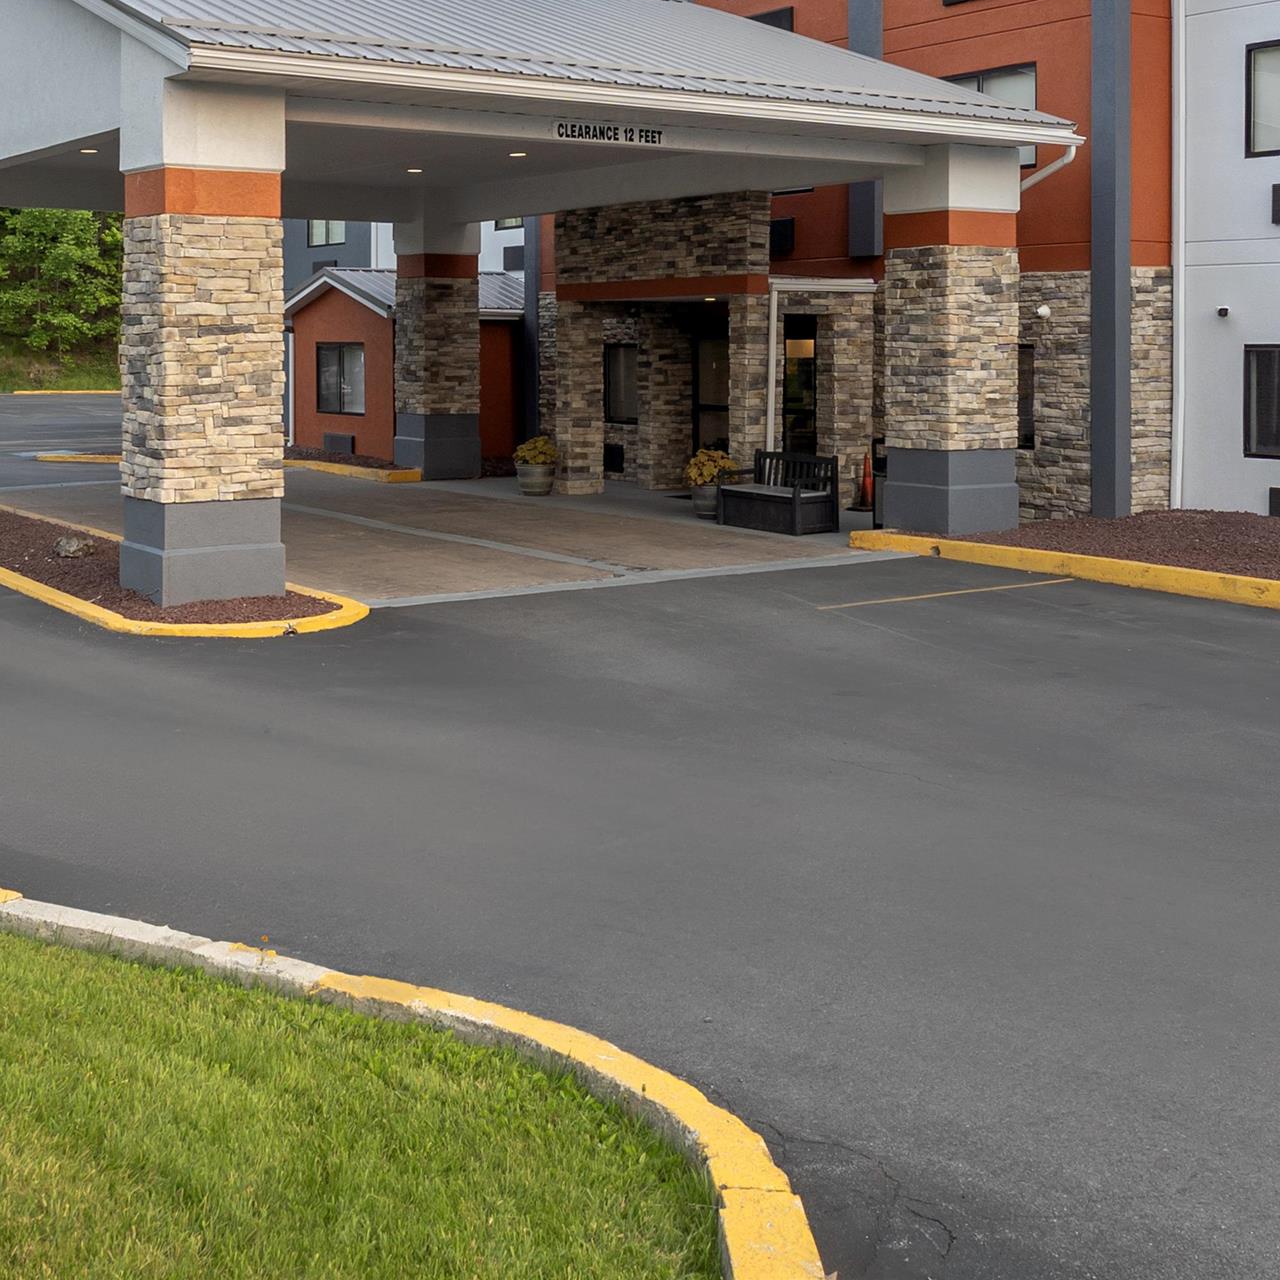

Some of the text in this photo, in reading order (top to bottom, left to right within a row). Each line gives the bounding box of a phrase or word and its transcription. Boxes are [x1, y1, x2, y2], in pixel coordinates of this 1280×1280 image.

[557, 123, 662, 144] CLEARANCE 12 FEET
